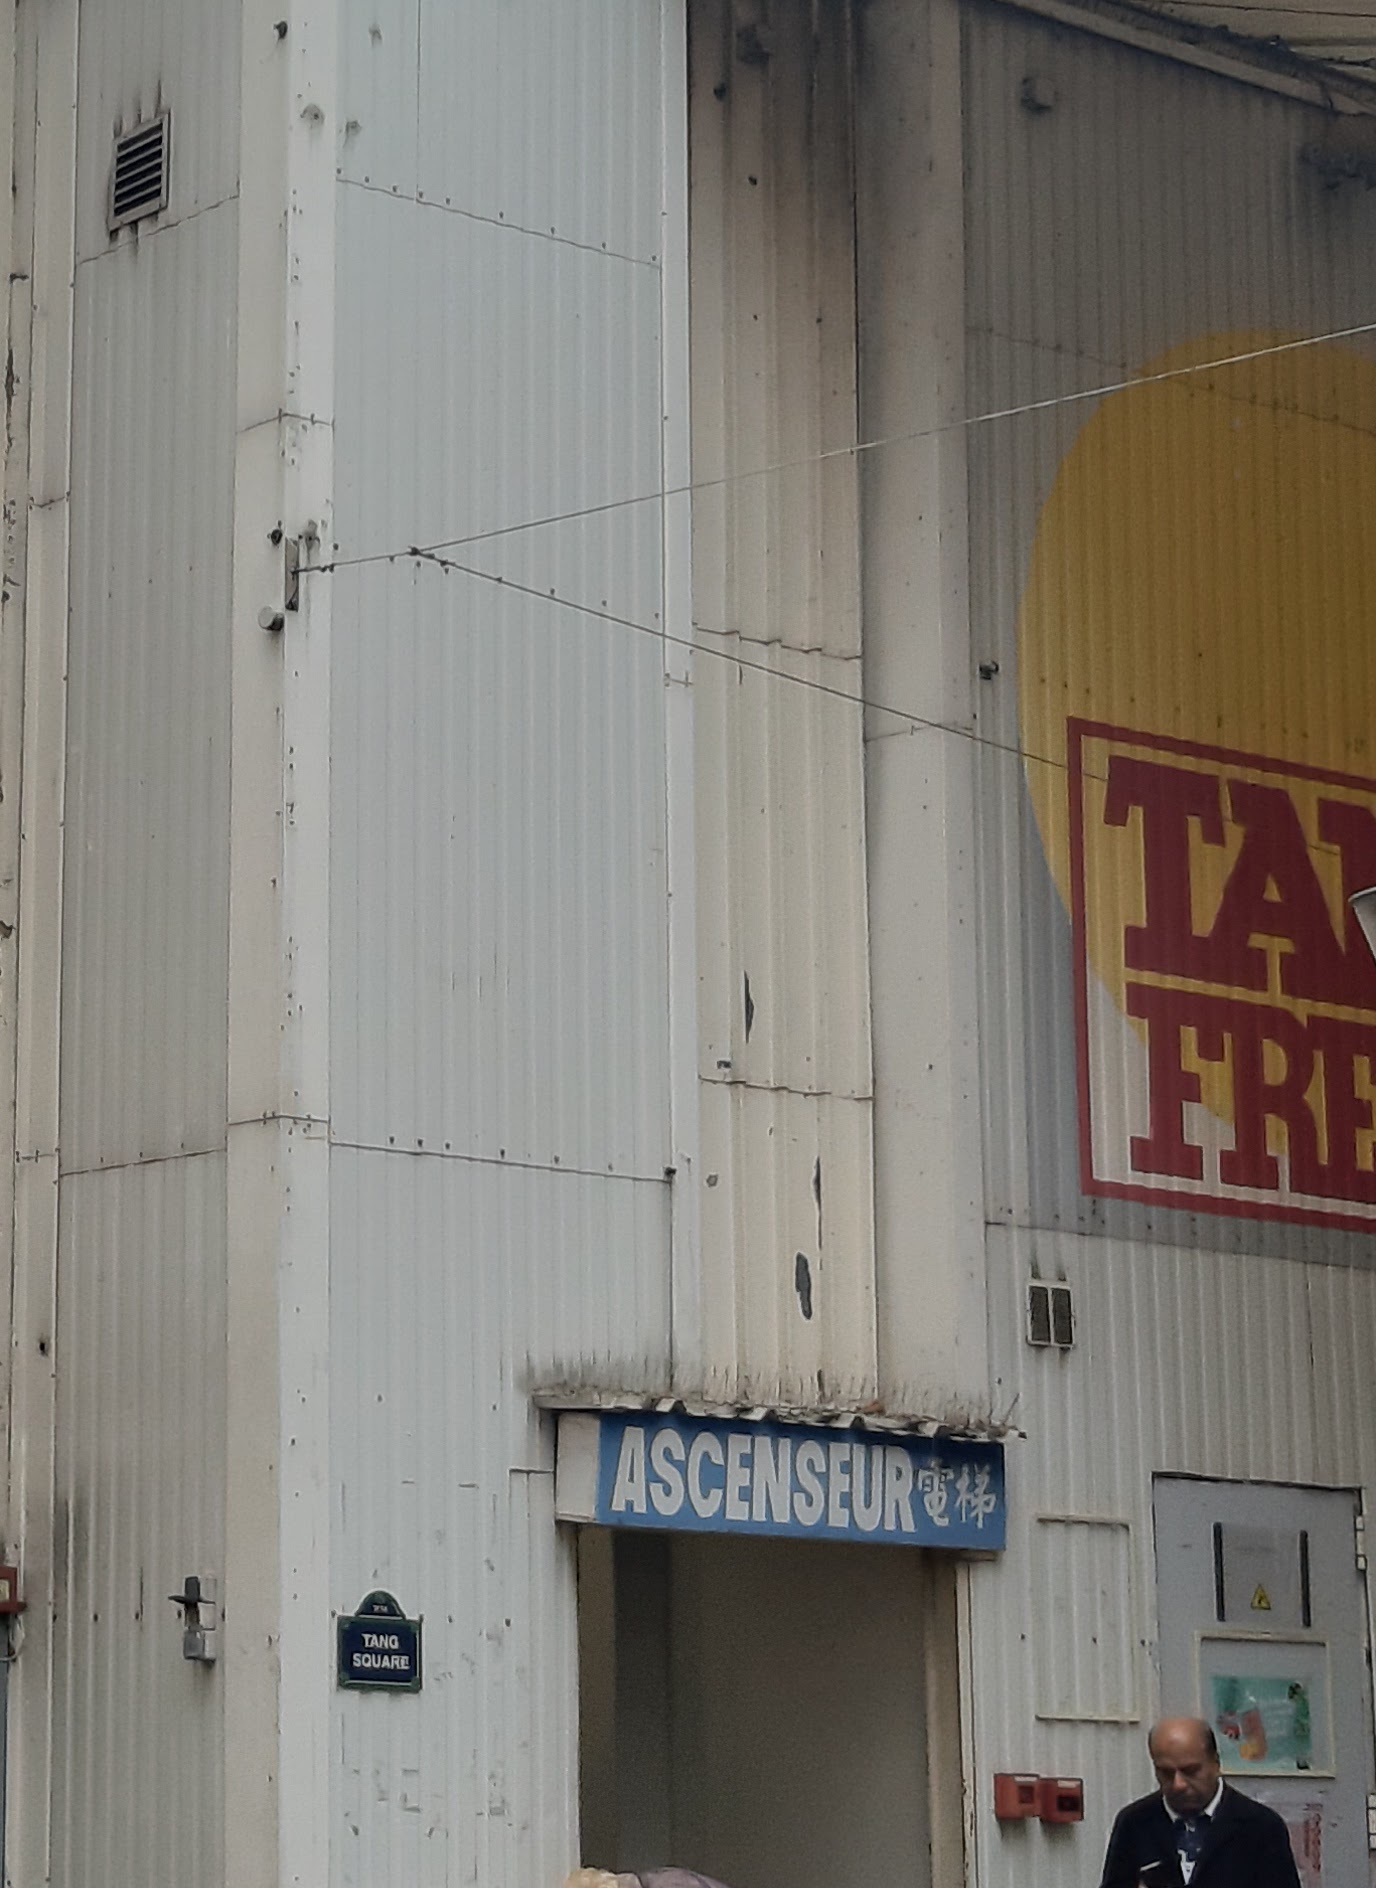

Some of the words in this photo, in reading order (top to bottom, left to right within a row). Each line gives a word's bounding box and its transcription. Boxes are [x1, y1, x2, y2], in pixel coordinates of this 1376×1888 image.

[610, 1424, 917, 1533] ASCENSEUR
[917, 1459, 997, 1529] 電梯
[352, 1652, 411, 1670] SQUARE
[361, 1633, 400, 1650] TANG
